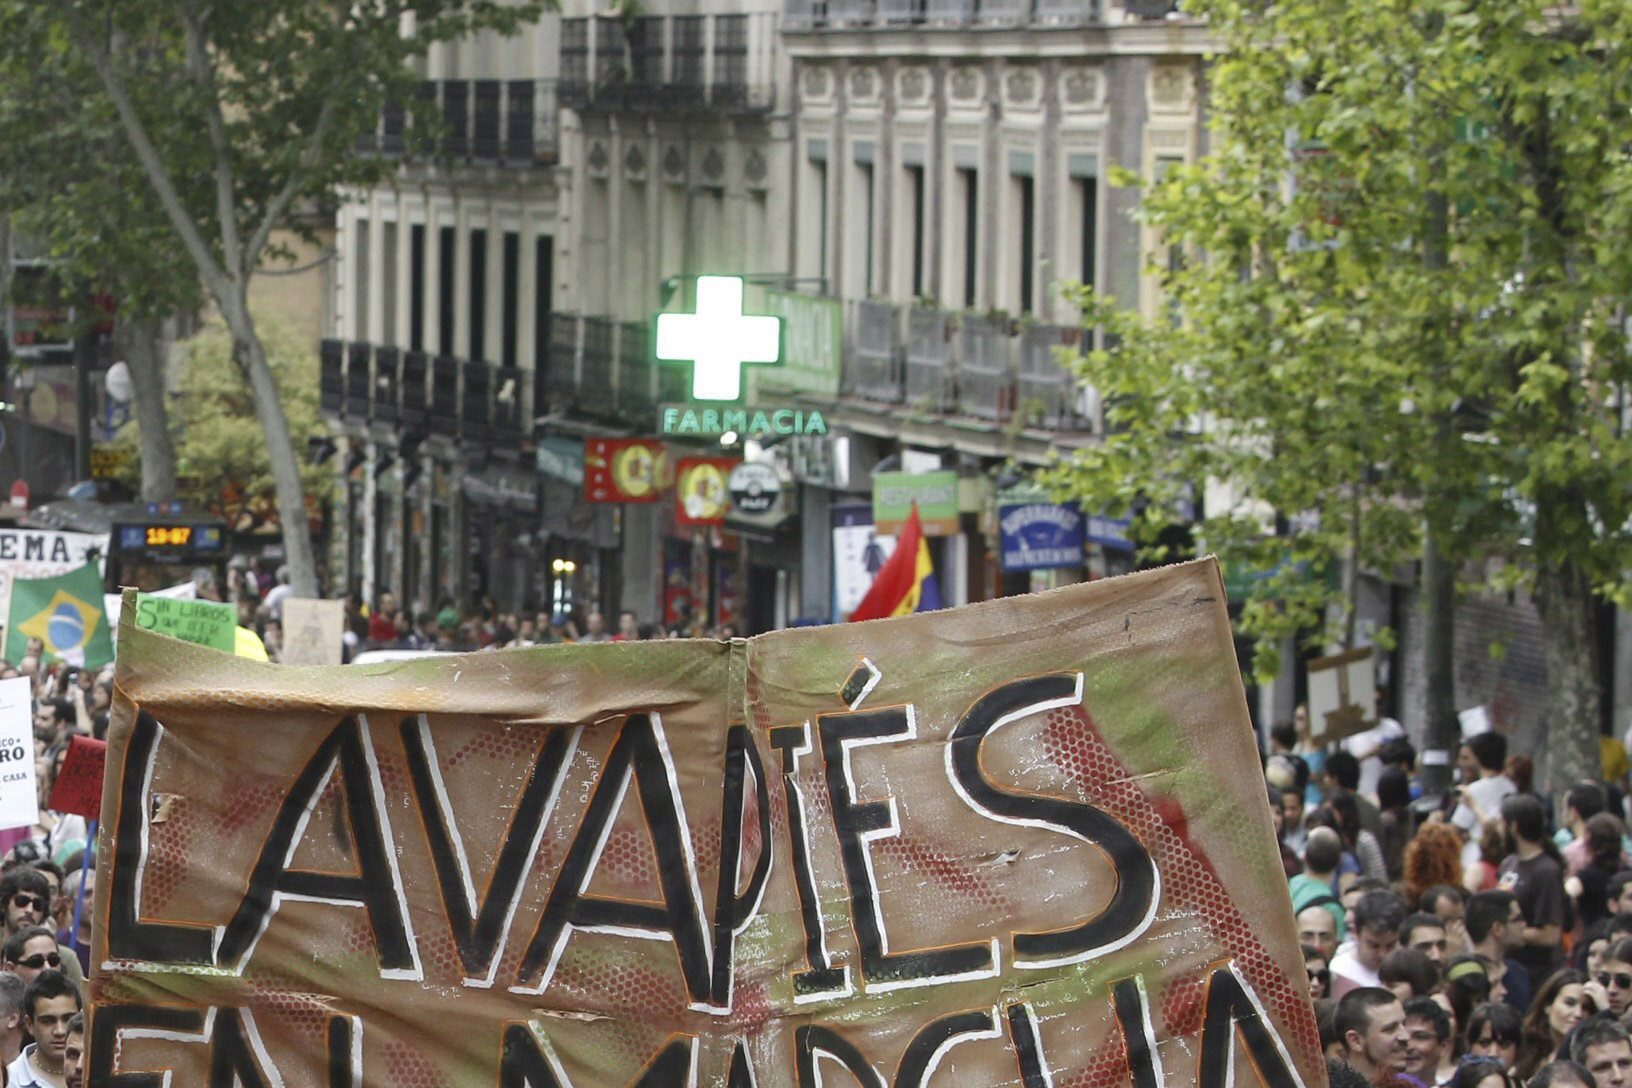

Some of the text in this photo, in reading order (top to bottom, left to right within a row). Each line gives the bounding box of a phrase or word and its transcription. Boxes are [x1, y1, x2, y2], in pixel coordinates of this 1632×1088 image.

[663, 408, 827, 435] FARMACIA
[2, 772, 28, 783] CASA
[101, 656, 1162, 1015] LAVAPIÉS
